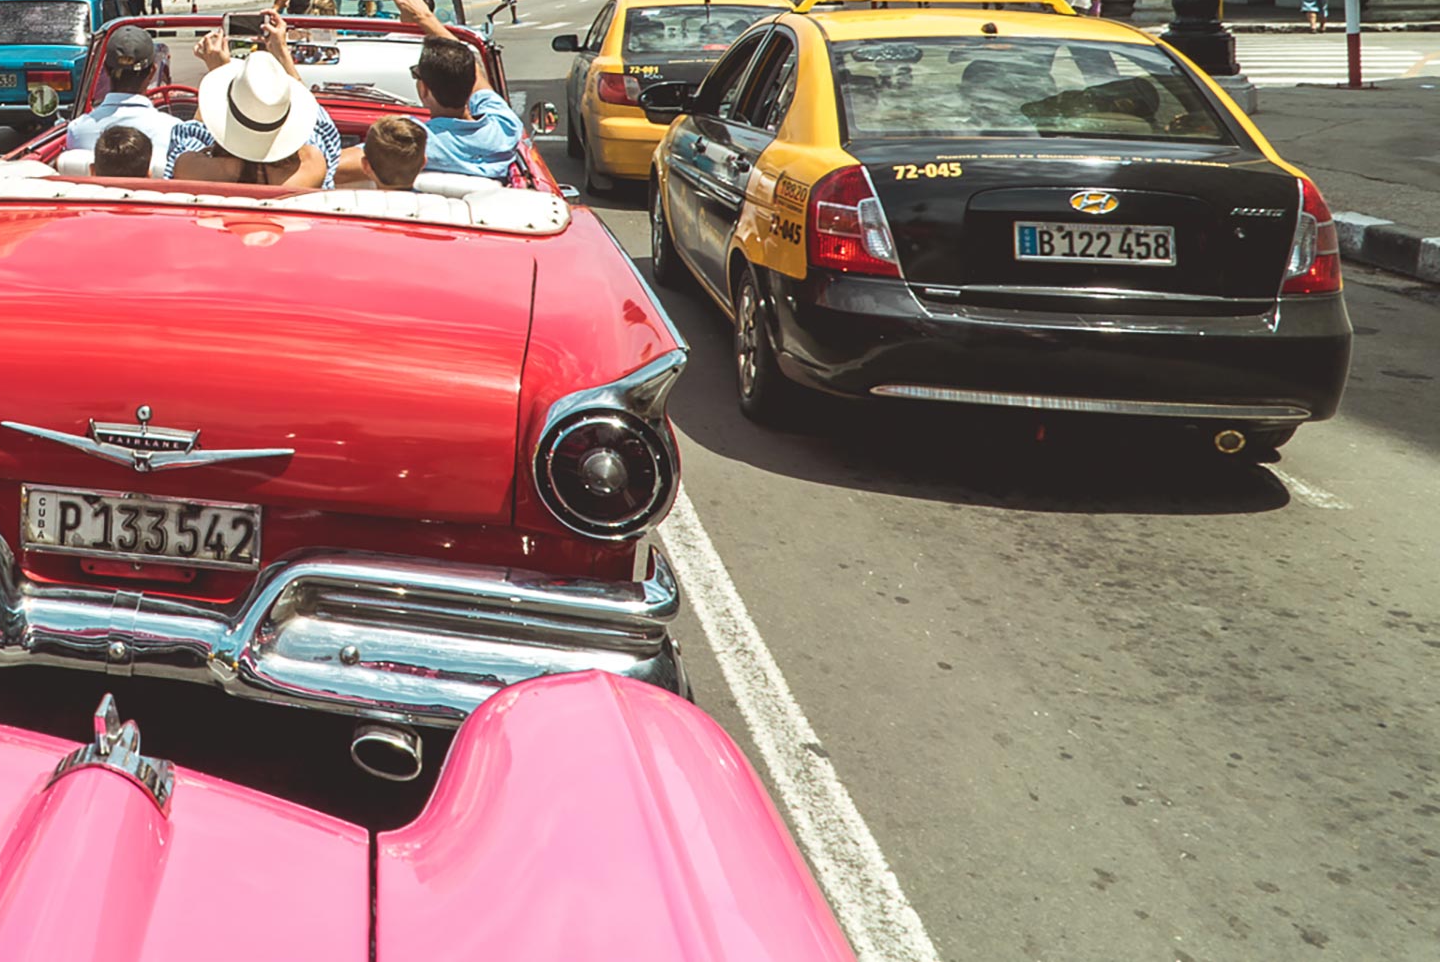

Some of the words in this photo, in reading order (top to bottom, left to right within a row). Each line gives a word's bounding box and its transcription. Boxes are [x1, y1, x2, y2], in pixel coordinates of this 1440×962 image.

[893, 162, 962, 180] 72-045
[109, 436, 180, 449] FAIRLANE
[38, 497, 47, 540] CUBA
